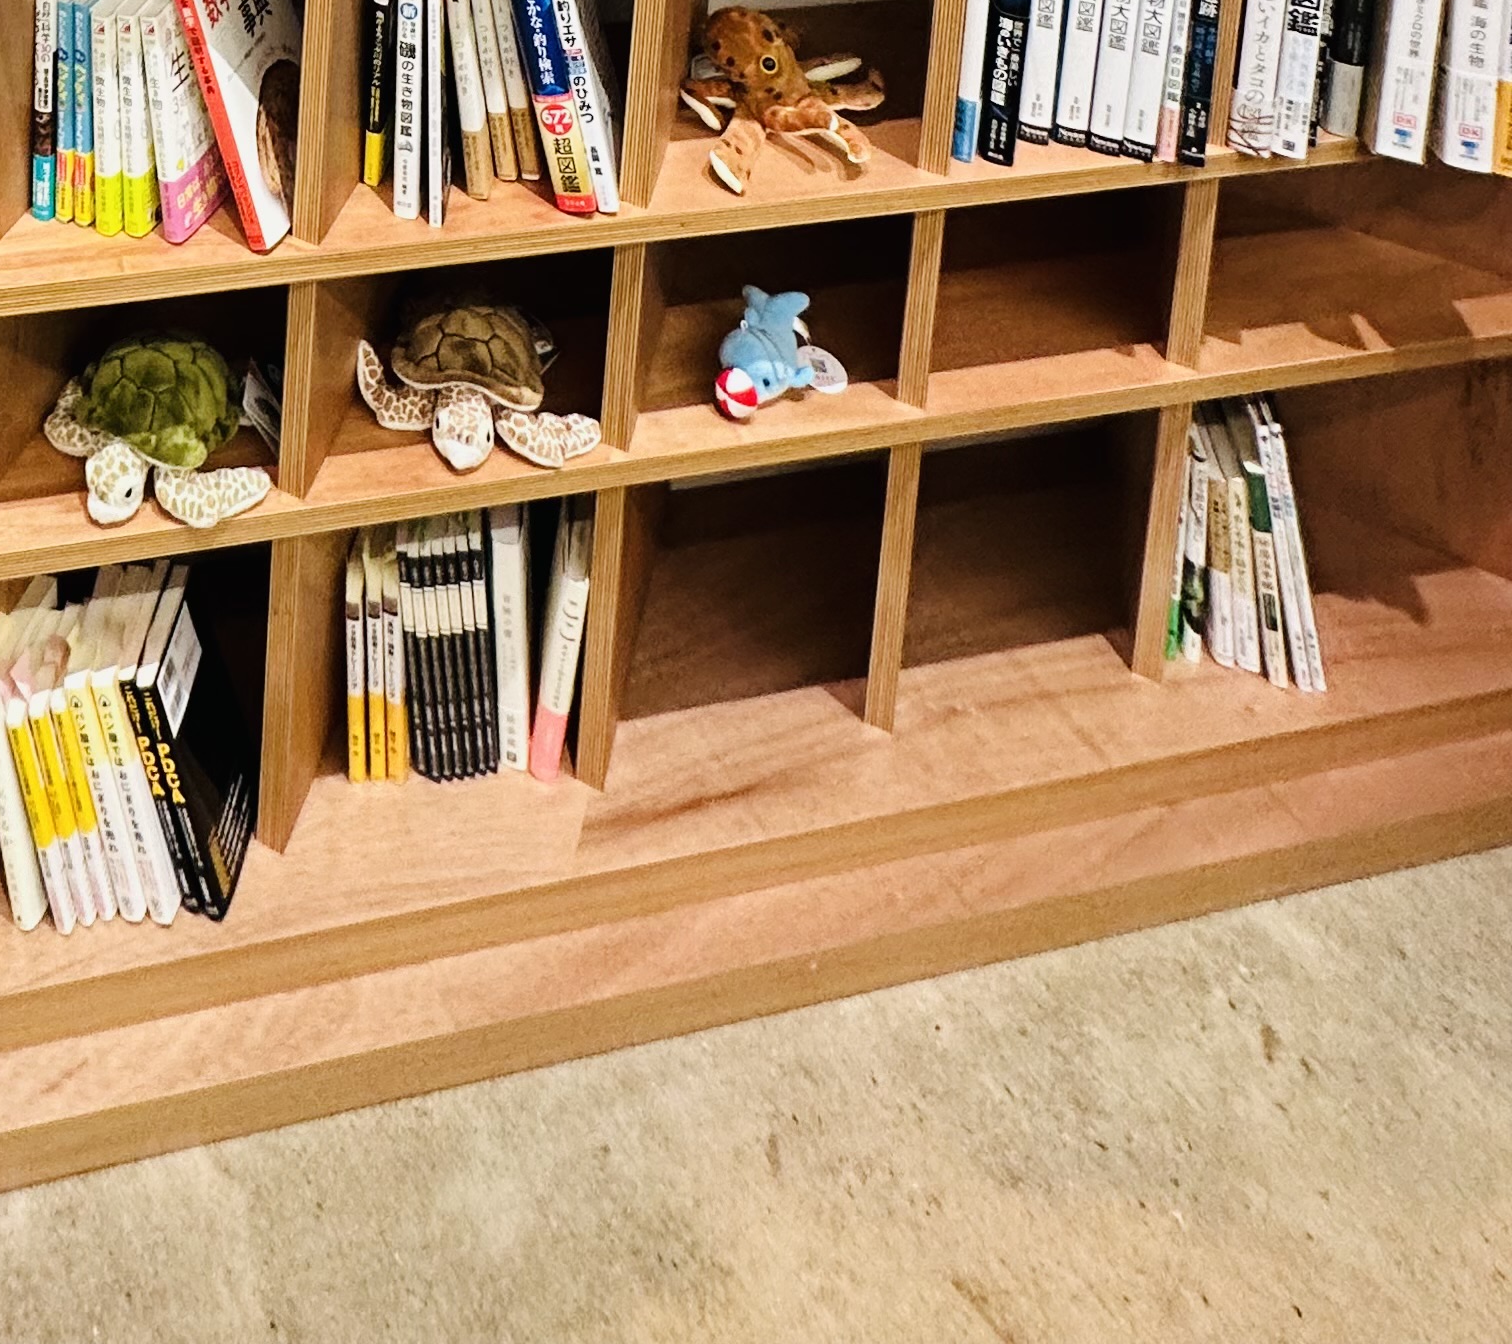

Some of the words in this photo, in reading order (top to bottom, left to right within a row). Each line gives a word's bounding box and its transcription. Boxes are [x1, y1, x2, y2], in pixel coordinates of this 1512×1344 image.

[557, 0, 577, 49] 釣りエサ
[574, 75, 594, 124] のひみつ
[1468, 15, 1487, 69] 海の生物
[399, 41, 417, 137] 磯の生き物図鑑
[1395, 116, 1414, 128] DK
[1461, 125, 1481, 137] DK
[554, 138, 581, 193] 超図鑑
[137, 736, 165, 797] PDCA
[157, 742, 186, 804] PDCA
